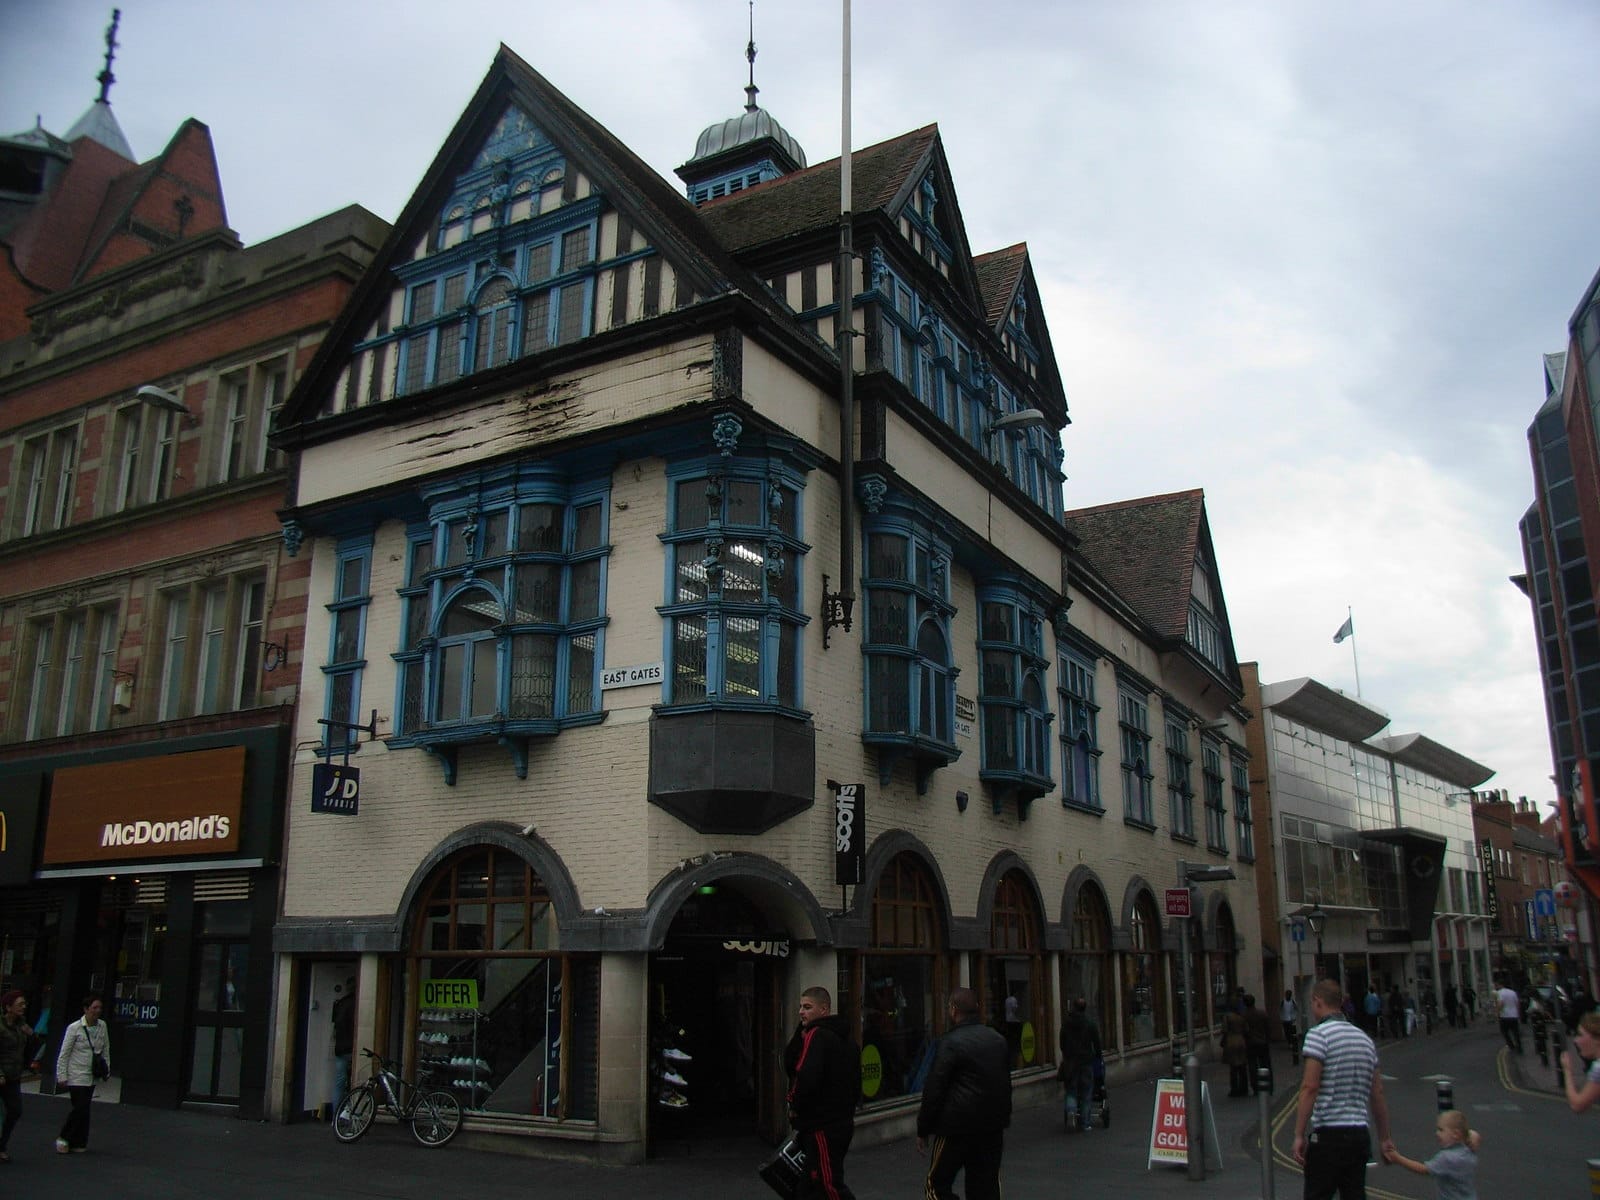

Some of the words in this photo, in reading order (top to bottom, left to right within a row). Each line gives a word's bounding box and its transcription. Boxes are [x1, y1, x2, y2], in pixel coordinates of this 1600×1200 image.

[603, 670, 627, 684] EAST
[631, 667, 661, 681] GATES
[102, 814, 230, 847] McDonald's
[425, 983, 470, 1004] OFFER
[1163, 1113, 1186, 1127] BU
